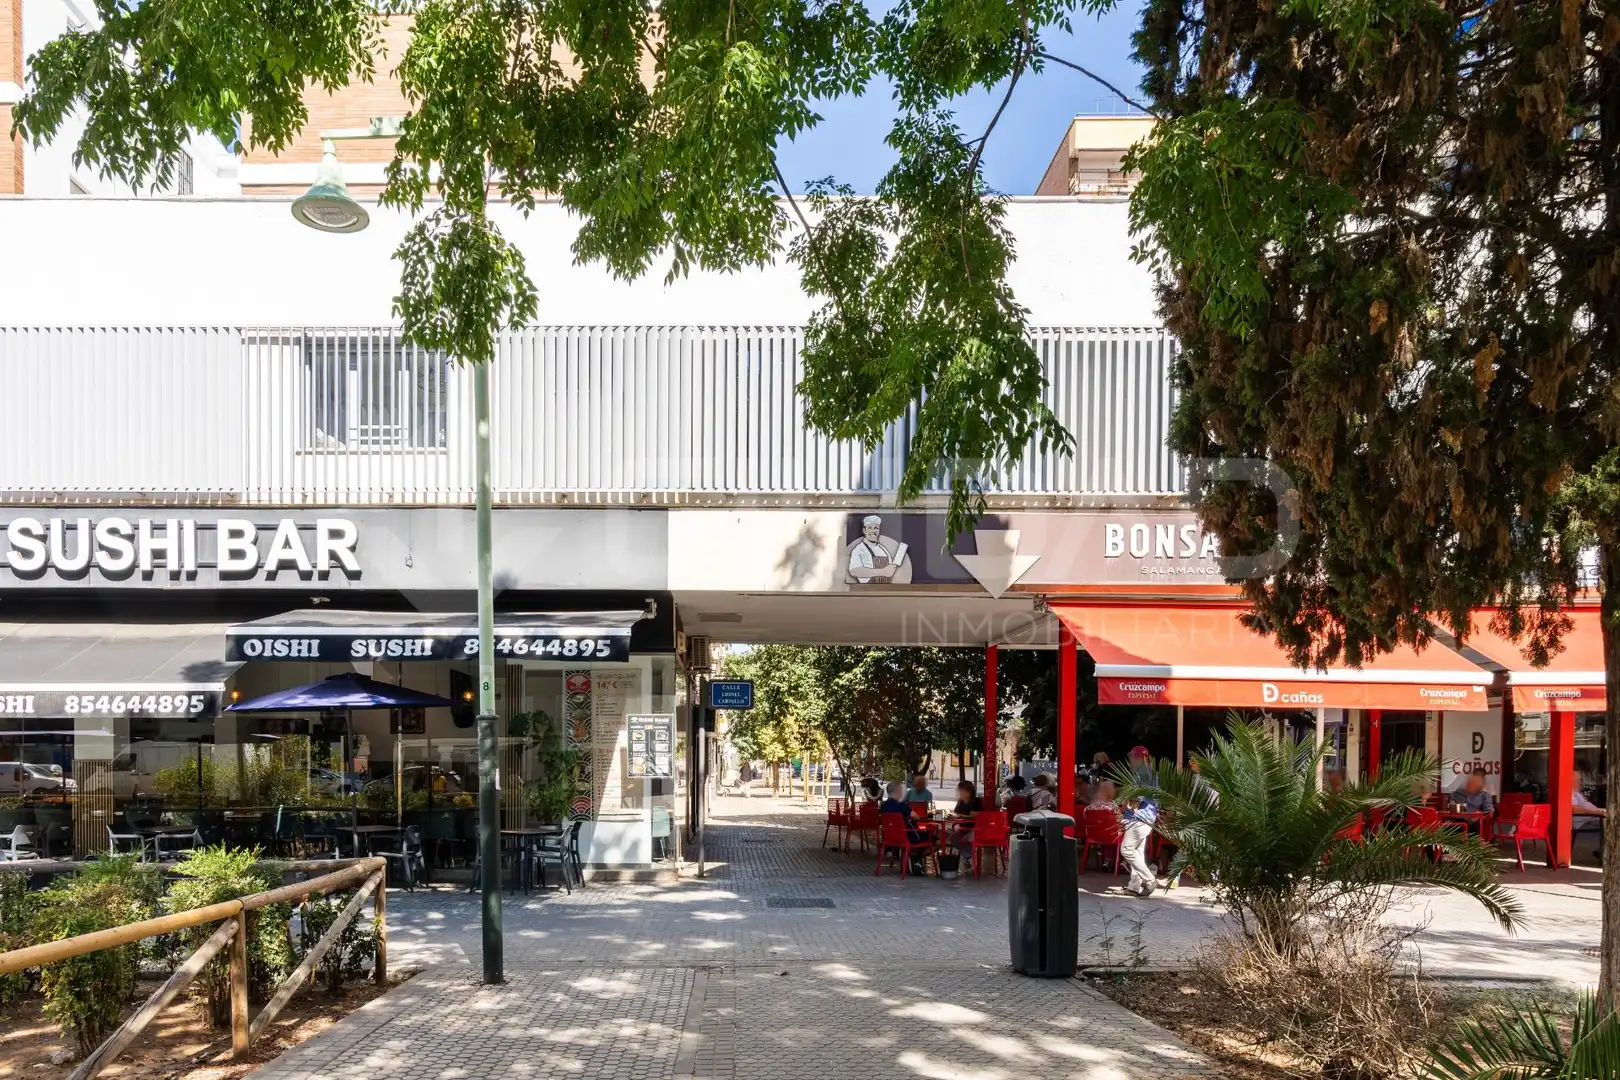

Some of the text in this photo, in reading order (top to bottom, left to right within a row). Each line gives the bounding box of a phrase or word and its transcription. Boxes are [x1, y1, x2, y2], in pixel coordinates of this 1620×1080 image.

[6, 516, 363, 578] SUSHI BAR
[243, 637, 611, 658] OISHI SUSHI 84644895
[483, 681, 490, 691] 8
[1119, 681, 1166, 693] Cruzcampo
[64, 695, 205, 713] 854644895
[1281, 690, 1324, 704] cañas
[1452, 757, 1501, 776] cañas
